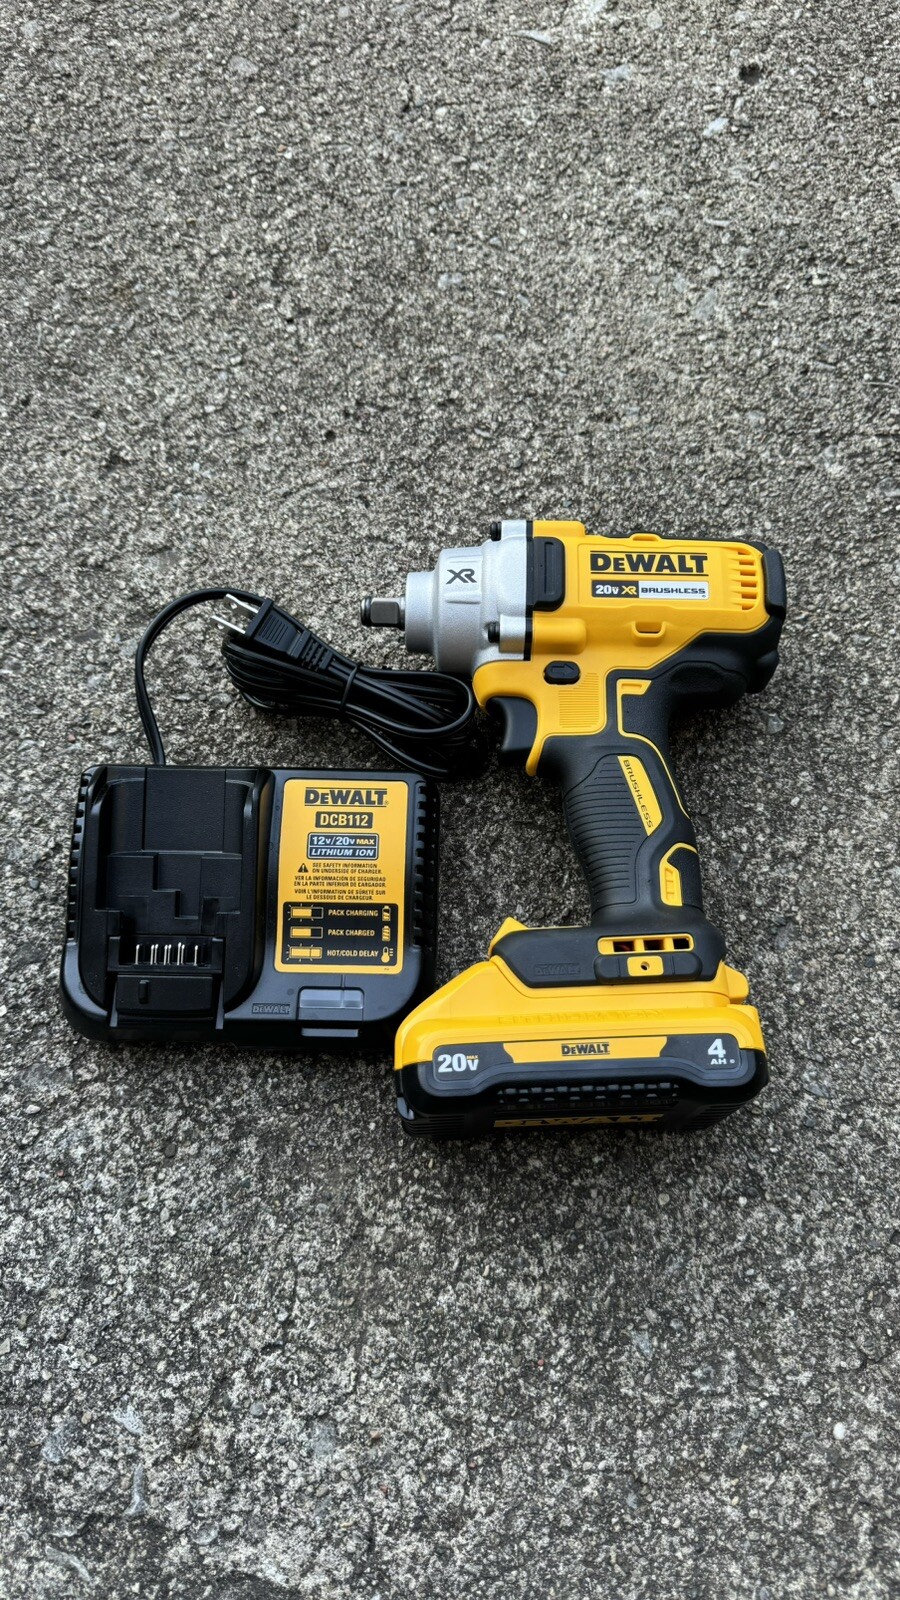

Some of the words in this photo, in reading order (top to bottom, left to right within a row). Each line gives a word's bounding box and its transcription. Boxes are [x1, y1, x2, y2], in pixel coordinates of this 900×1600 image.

[445, 568, 478, 585] XR
[621, 585, 637, 595] XR
[623, 759, 653, 828] BRUSHLESS
[320, 814, 368, 826] DCB112
[356, 849, 374, 857] ION
[327, 949, 358, 957] HOT/COLD
[708, 1038, 726, 1058] 4
